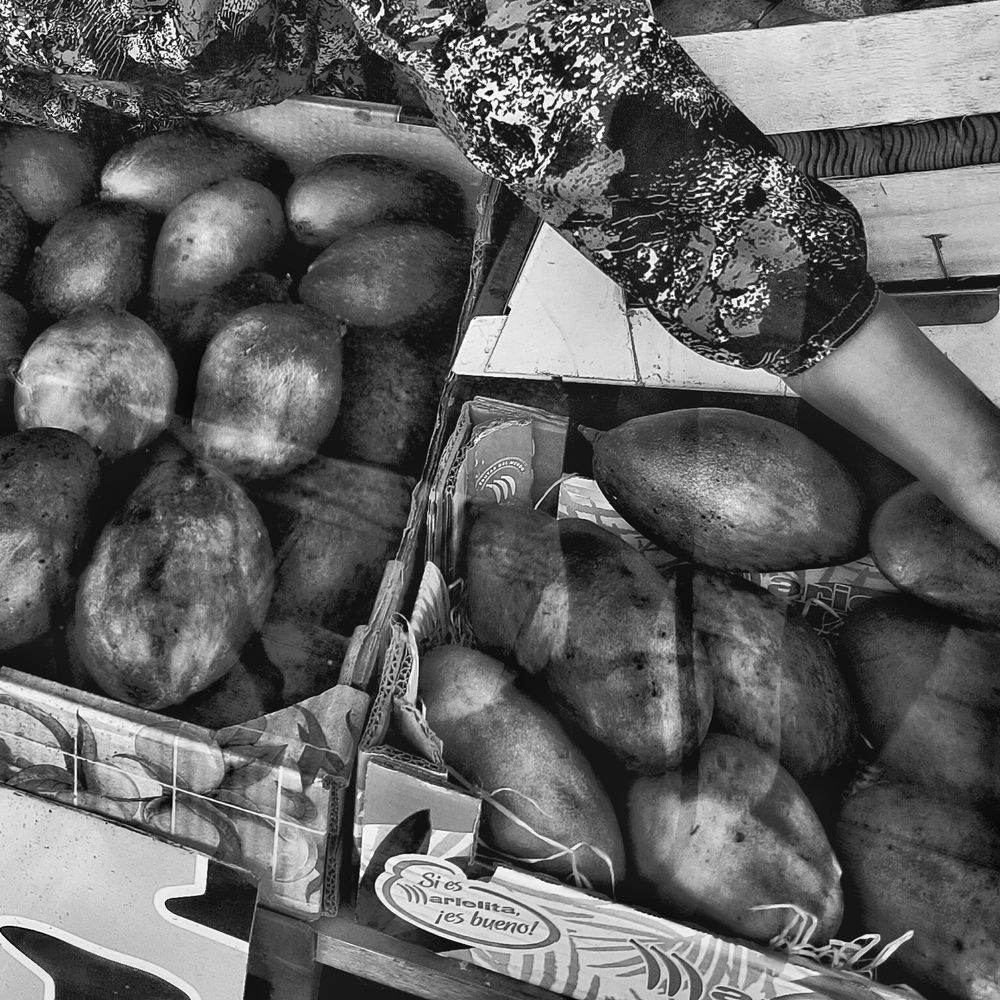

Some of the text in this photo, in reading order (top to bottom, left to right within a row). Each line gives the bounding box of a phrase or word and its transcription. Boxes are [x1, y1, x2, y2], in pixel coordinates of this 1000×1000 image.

[417, 871, 463, 892] Si es
[434, 910, 540, 936] ¡es bueno!
